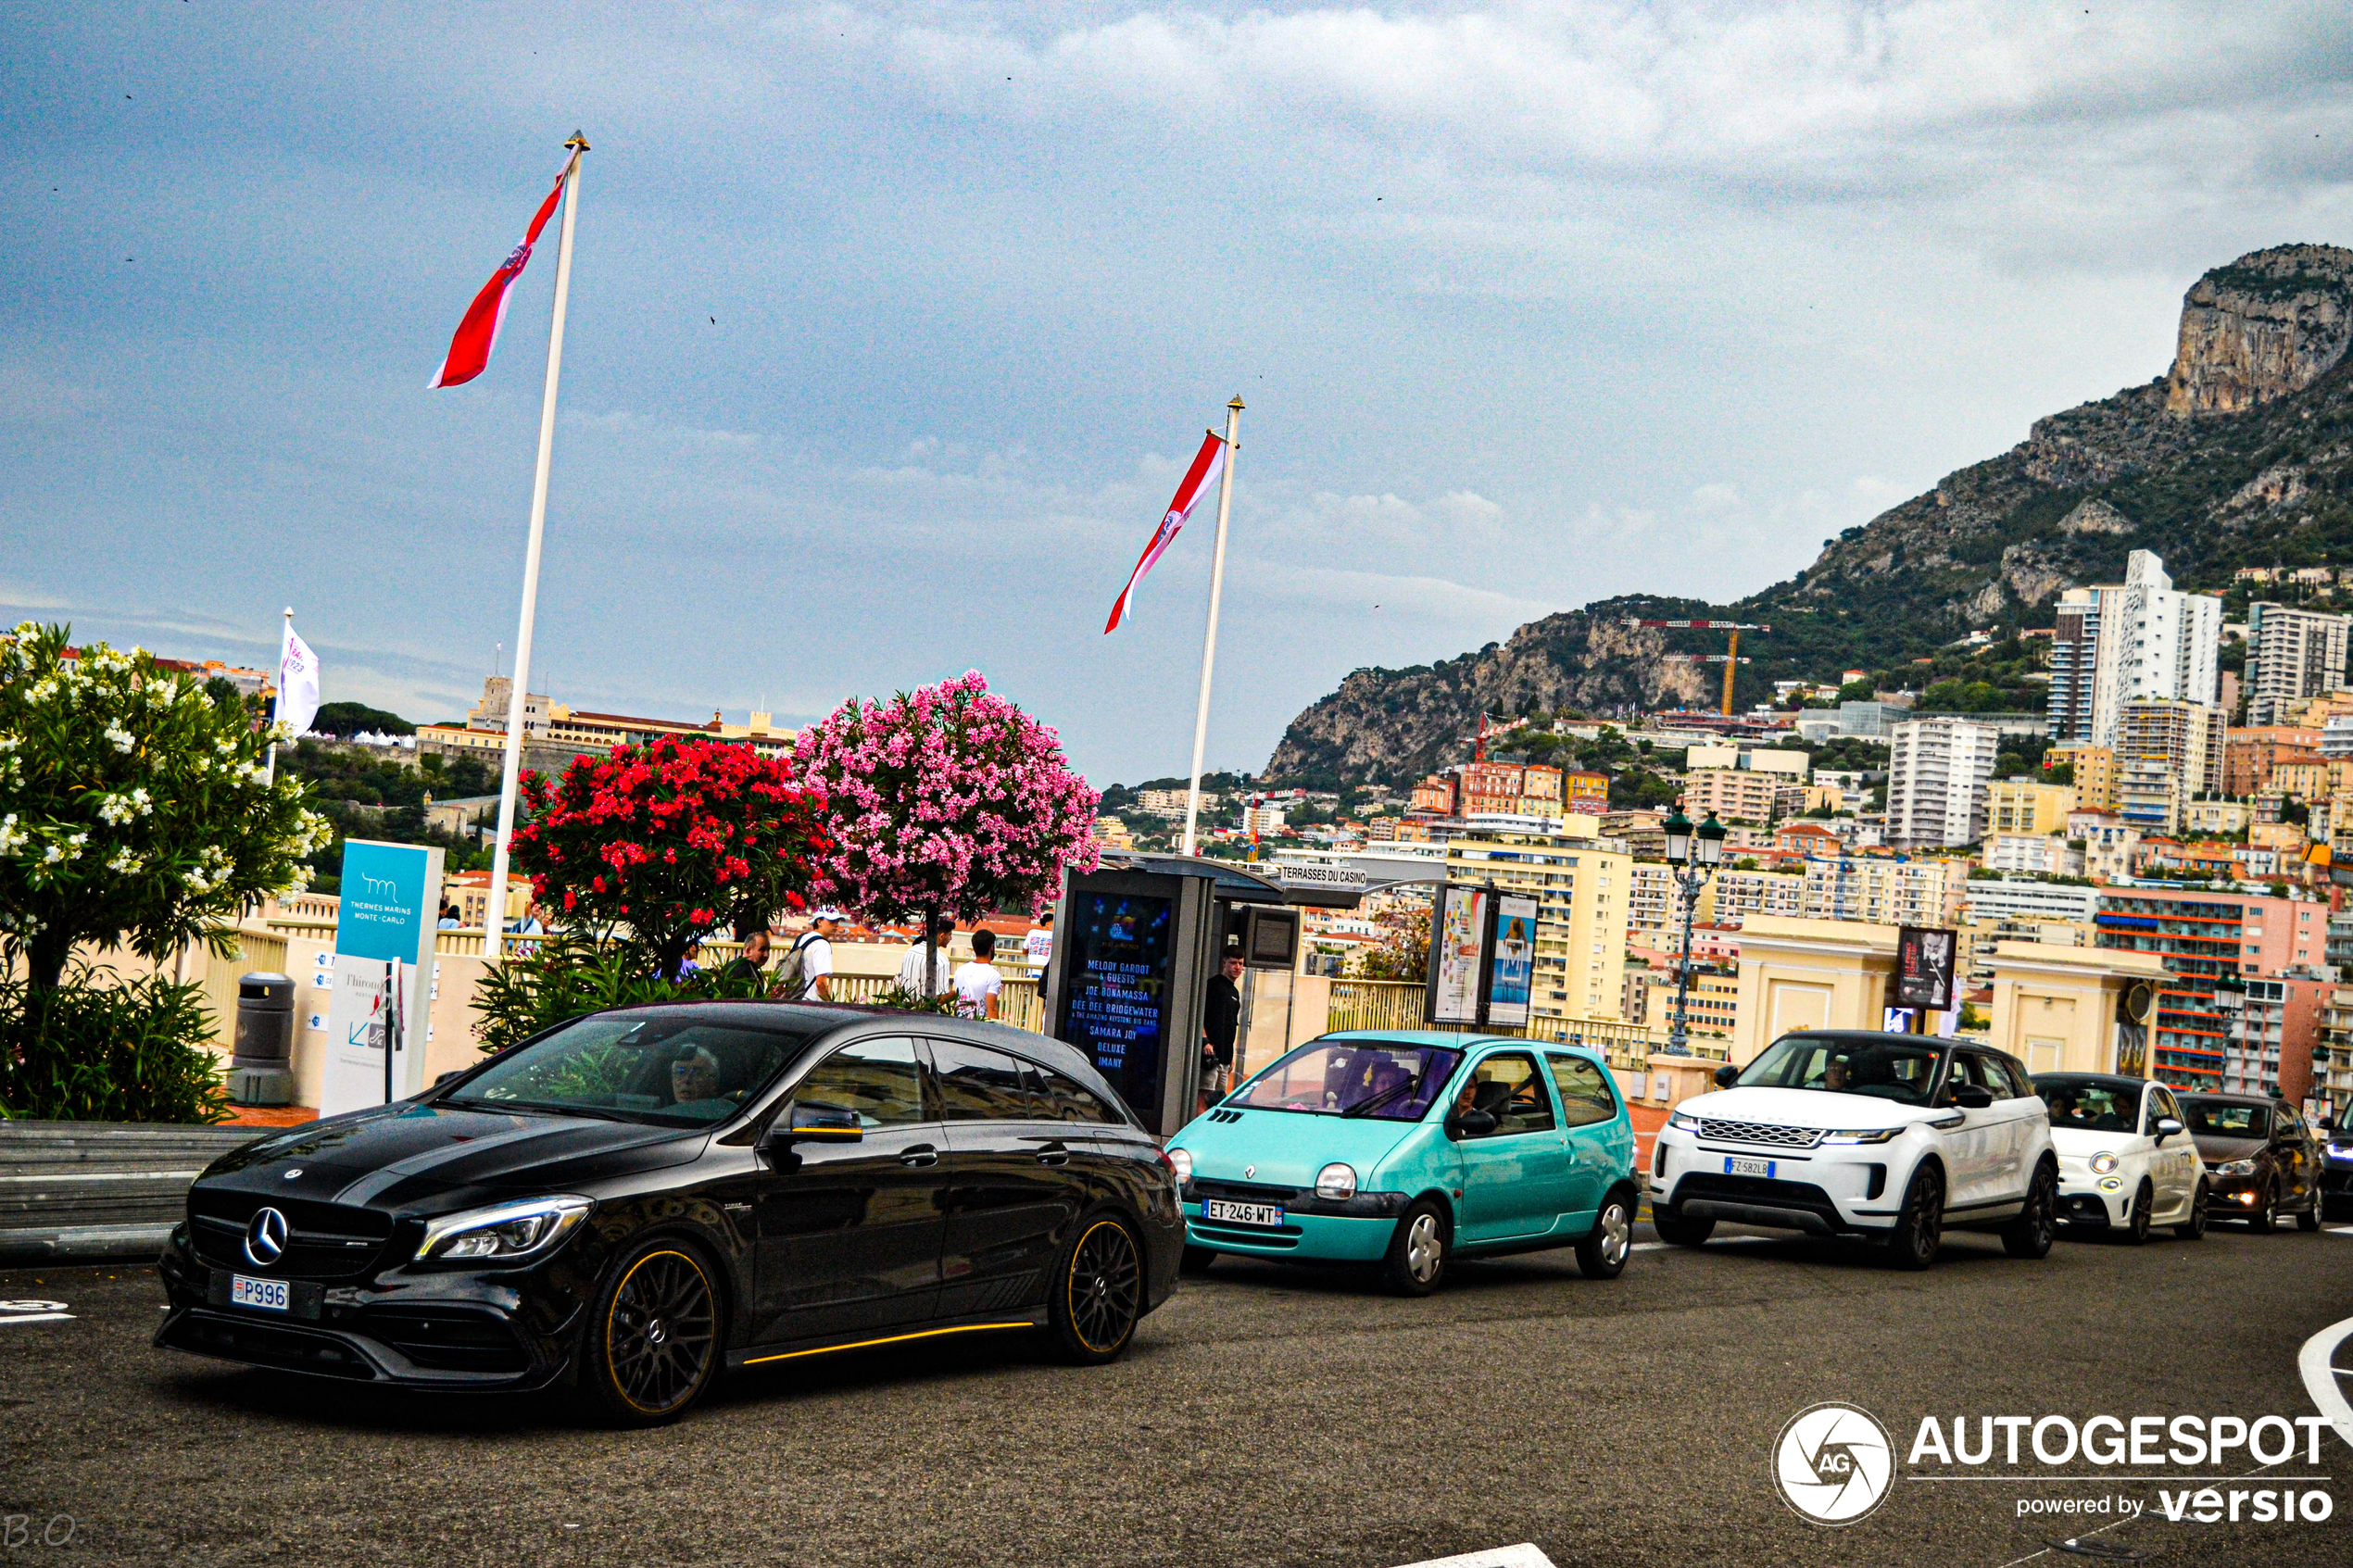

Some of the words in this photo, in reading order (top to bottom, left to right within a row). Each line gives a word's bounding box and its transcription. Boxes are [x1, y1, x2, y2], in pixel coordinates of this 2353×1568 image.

[1283, 867, 1327, 881] TERRASSES
[1327, 871, 1339, 882] DU
[1340, 871, 1366, 884] CASINO
[351, 901, 383, 911] THERMES
[384, 906, 411, 915] MARINS
[1088, 960, 1117, 972] MELODY
[1119, 963, 1151, 974] GARDOT
[347, 973, 384, 990] l'hirond
[1099, 972, 1104, 981] &
[1107, 972, 1136, 985] GUESTS
[1086, 985, 1099, 996] JOE
[1101, 987, 1149, 1001] BONAMASSA
[1072, 1000, 1086, 1010] DEE
[1088, 1001, 1103, 1011] DEE
[1106, 1003, 1158, 1018] BRIDGEWATER
[1086, 1012, 1108, 1021] AMAZING
[1109, 1015, 1132, 1024] KEYSTONE
[1089, 1025, 1122, 1038] SAMARA
[1124, 1030, 1138, 1040] JOY
[1097, 1042, 1126, 1054] DELUXE
[1098, 1056, 1123, 1068] IMANY
[1731, 1160, 1741, 1172] FZ
[1743, 1162, 1768, 1174] 582LB
[245, 1281, 285, 1306] P996
